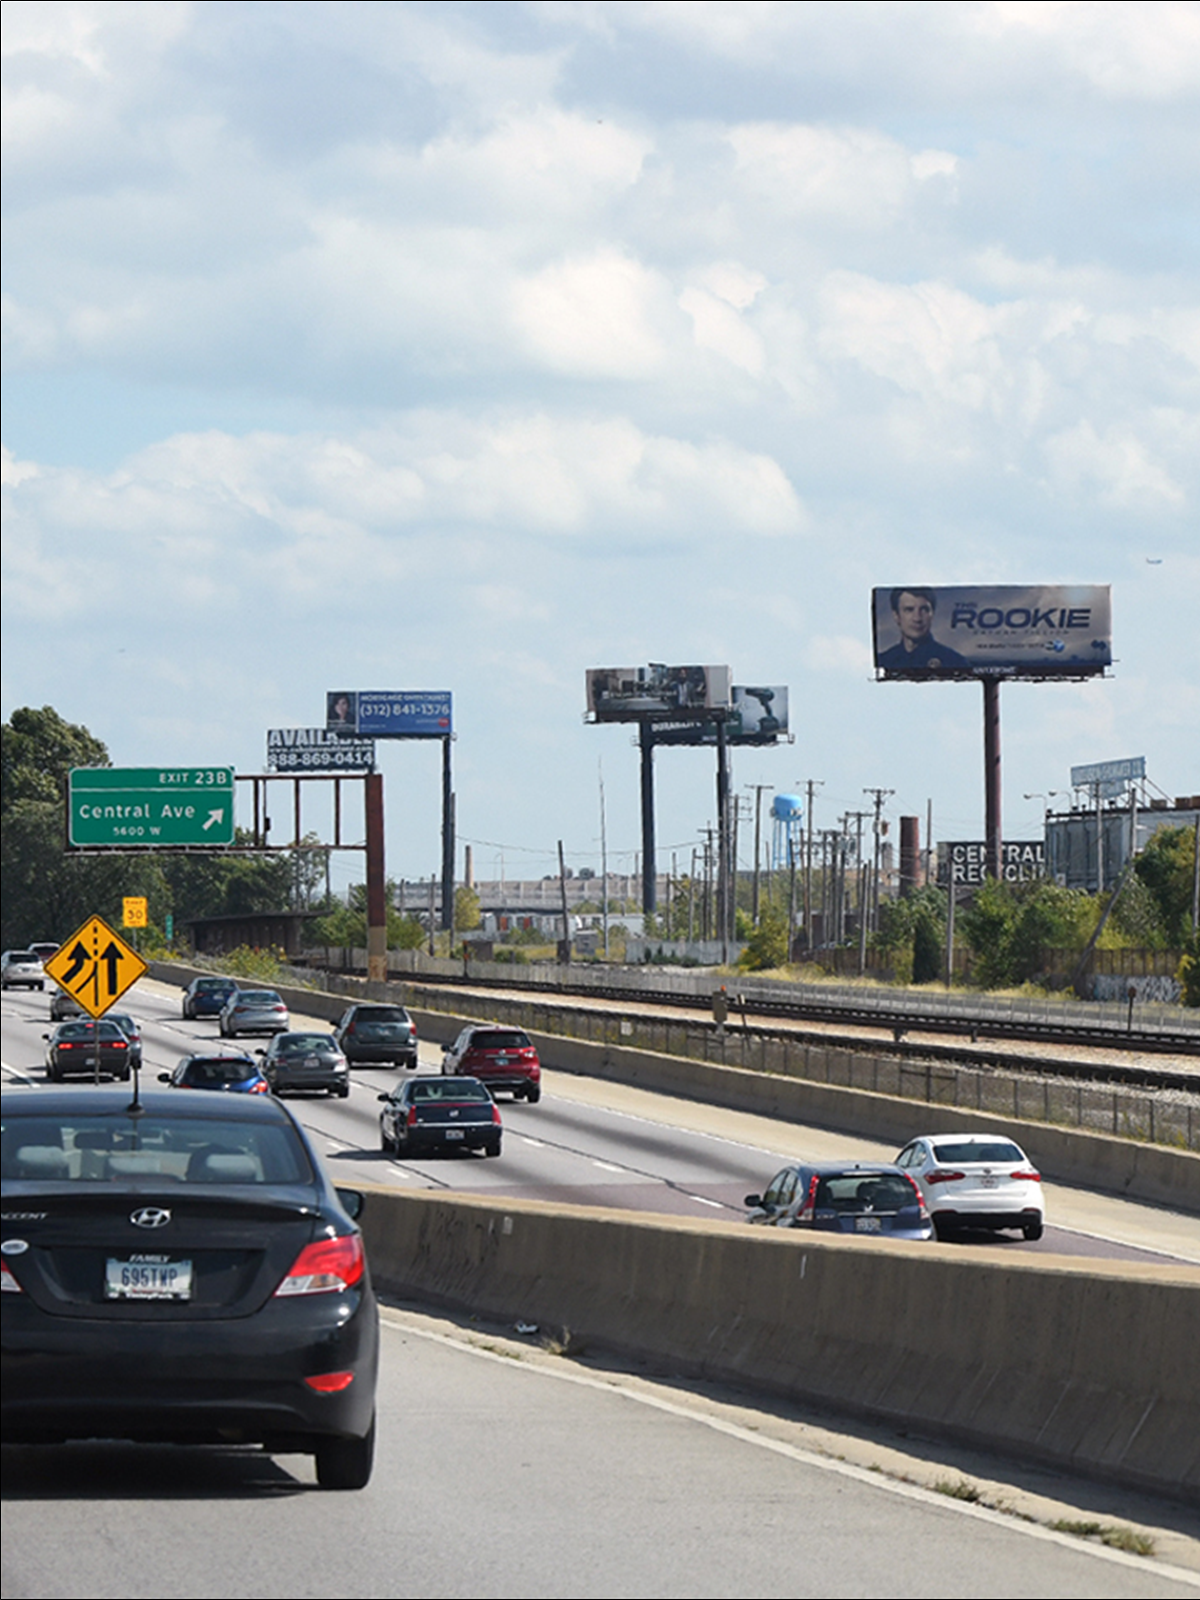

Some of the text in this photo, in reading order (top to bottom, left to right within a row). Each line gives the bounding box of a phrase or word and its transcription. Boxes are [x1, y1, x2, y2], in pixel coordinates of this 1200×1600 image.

[950, 607, 1092, 630] ROOKIE
[360, 702, 450, 718] (312) 841-1376
[268, 729, 374, 746] AVAILA
[268, 751, 374, 766] 888-869-0414
[158, 771, 228, 785] EXIT 23B
[79, 803, 196, 819] Central Ave
[112, 826, 162, 837] 5600 W
[129, 1254, 171, 1263] FAMILY
